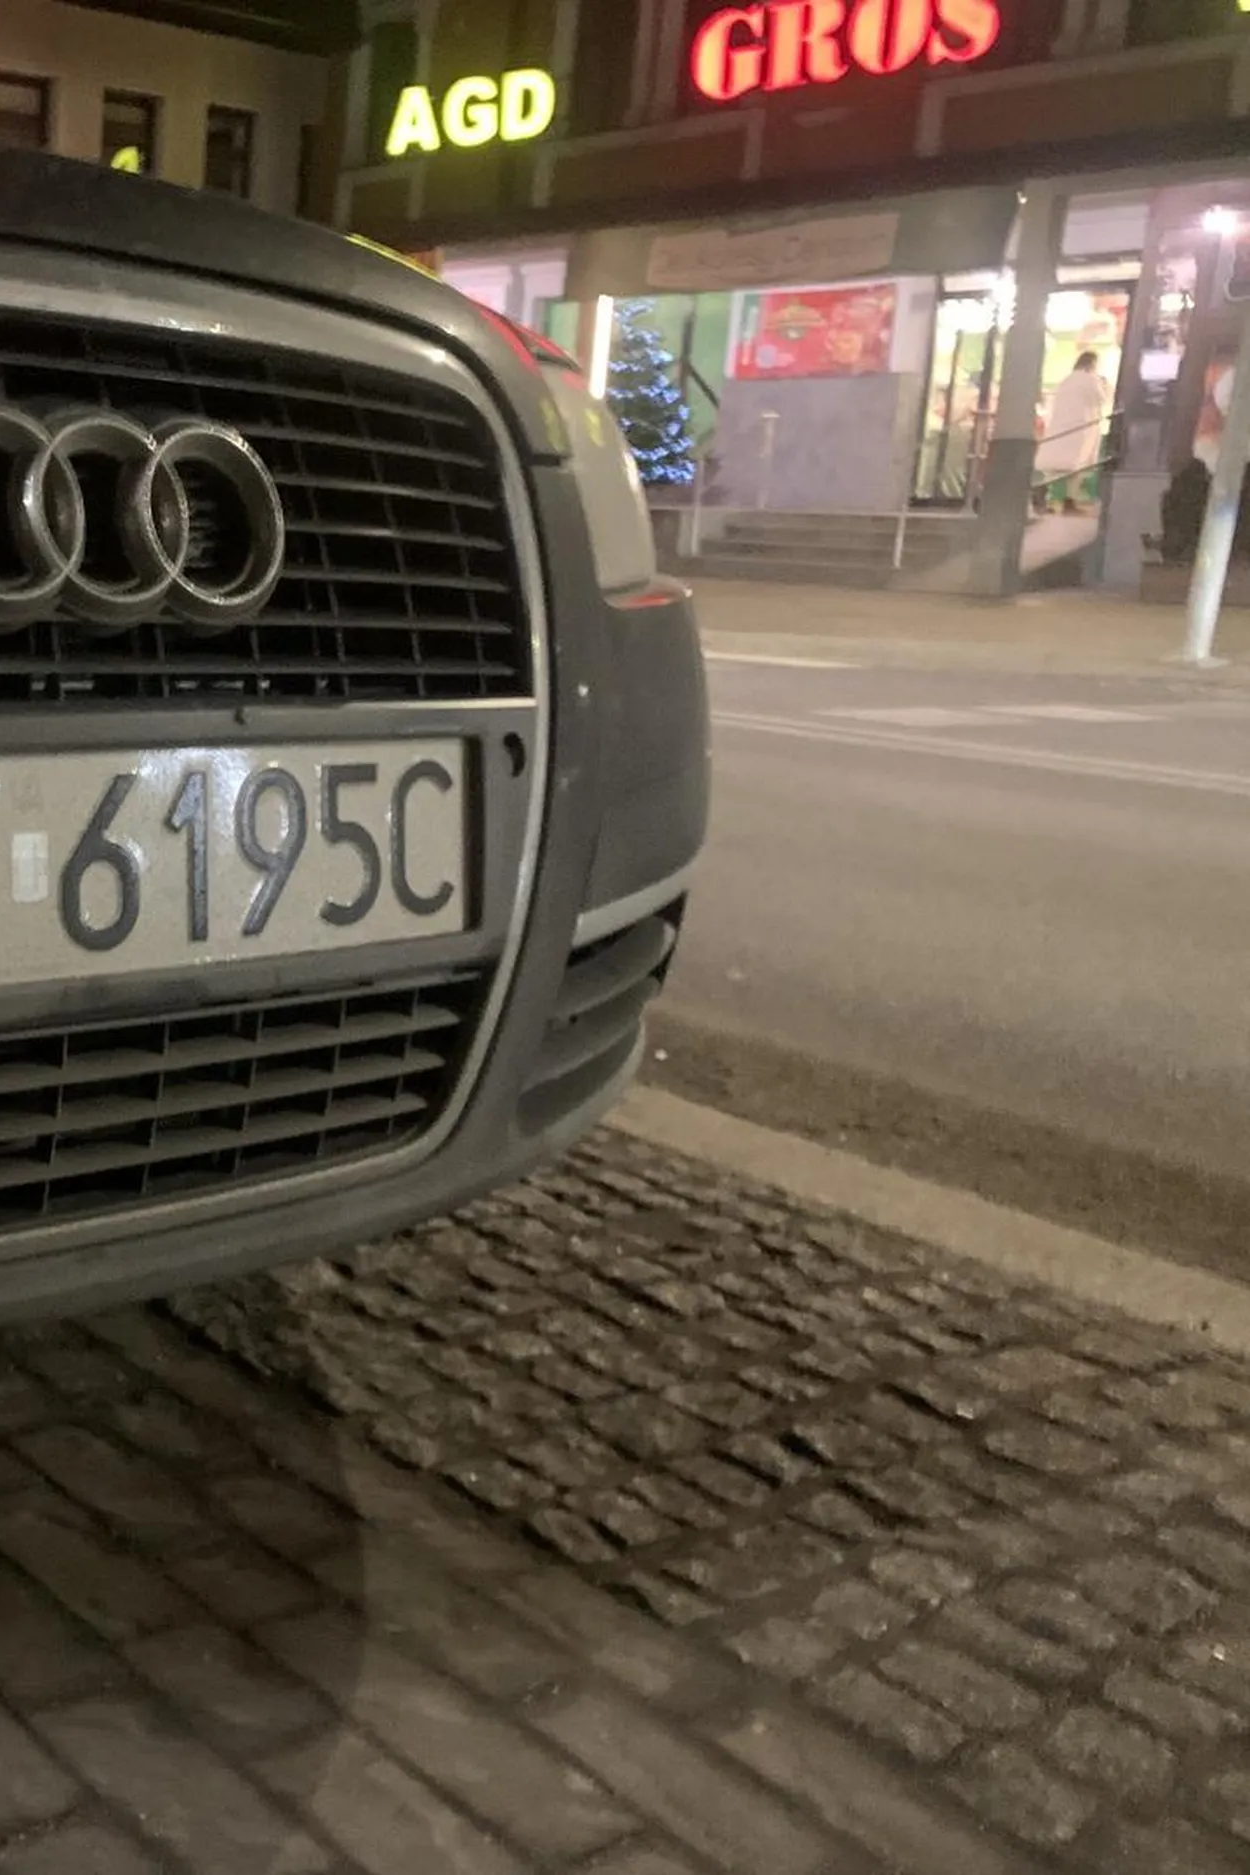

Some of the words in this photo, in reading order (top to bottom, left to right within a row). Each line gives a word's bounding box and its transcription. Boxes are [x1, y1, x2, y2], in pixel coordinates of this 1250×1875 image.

[691, 0, 999, 100] GROS
[386, 68, 555, 155] AGD
[60, 760, 455, 953] 6195C
